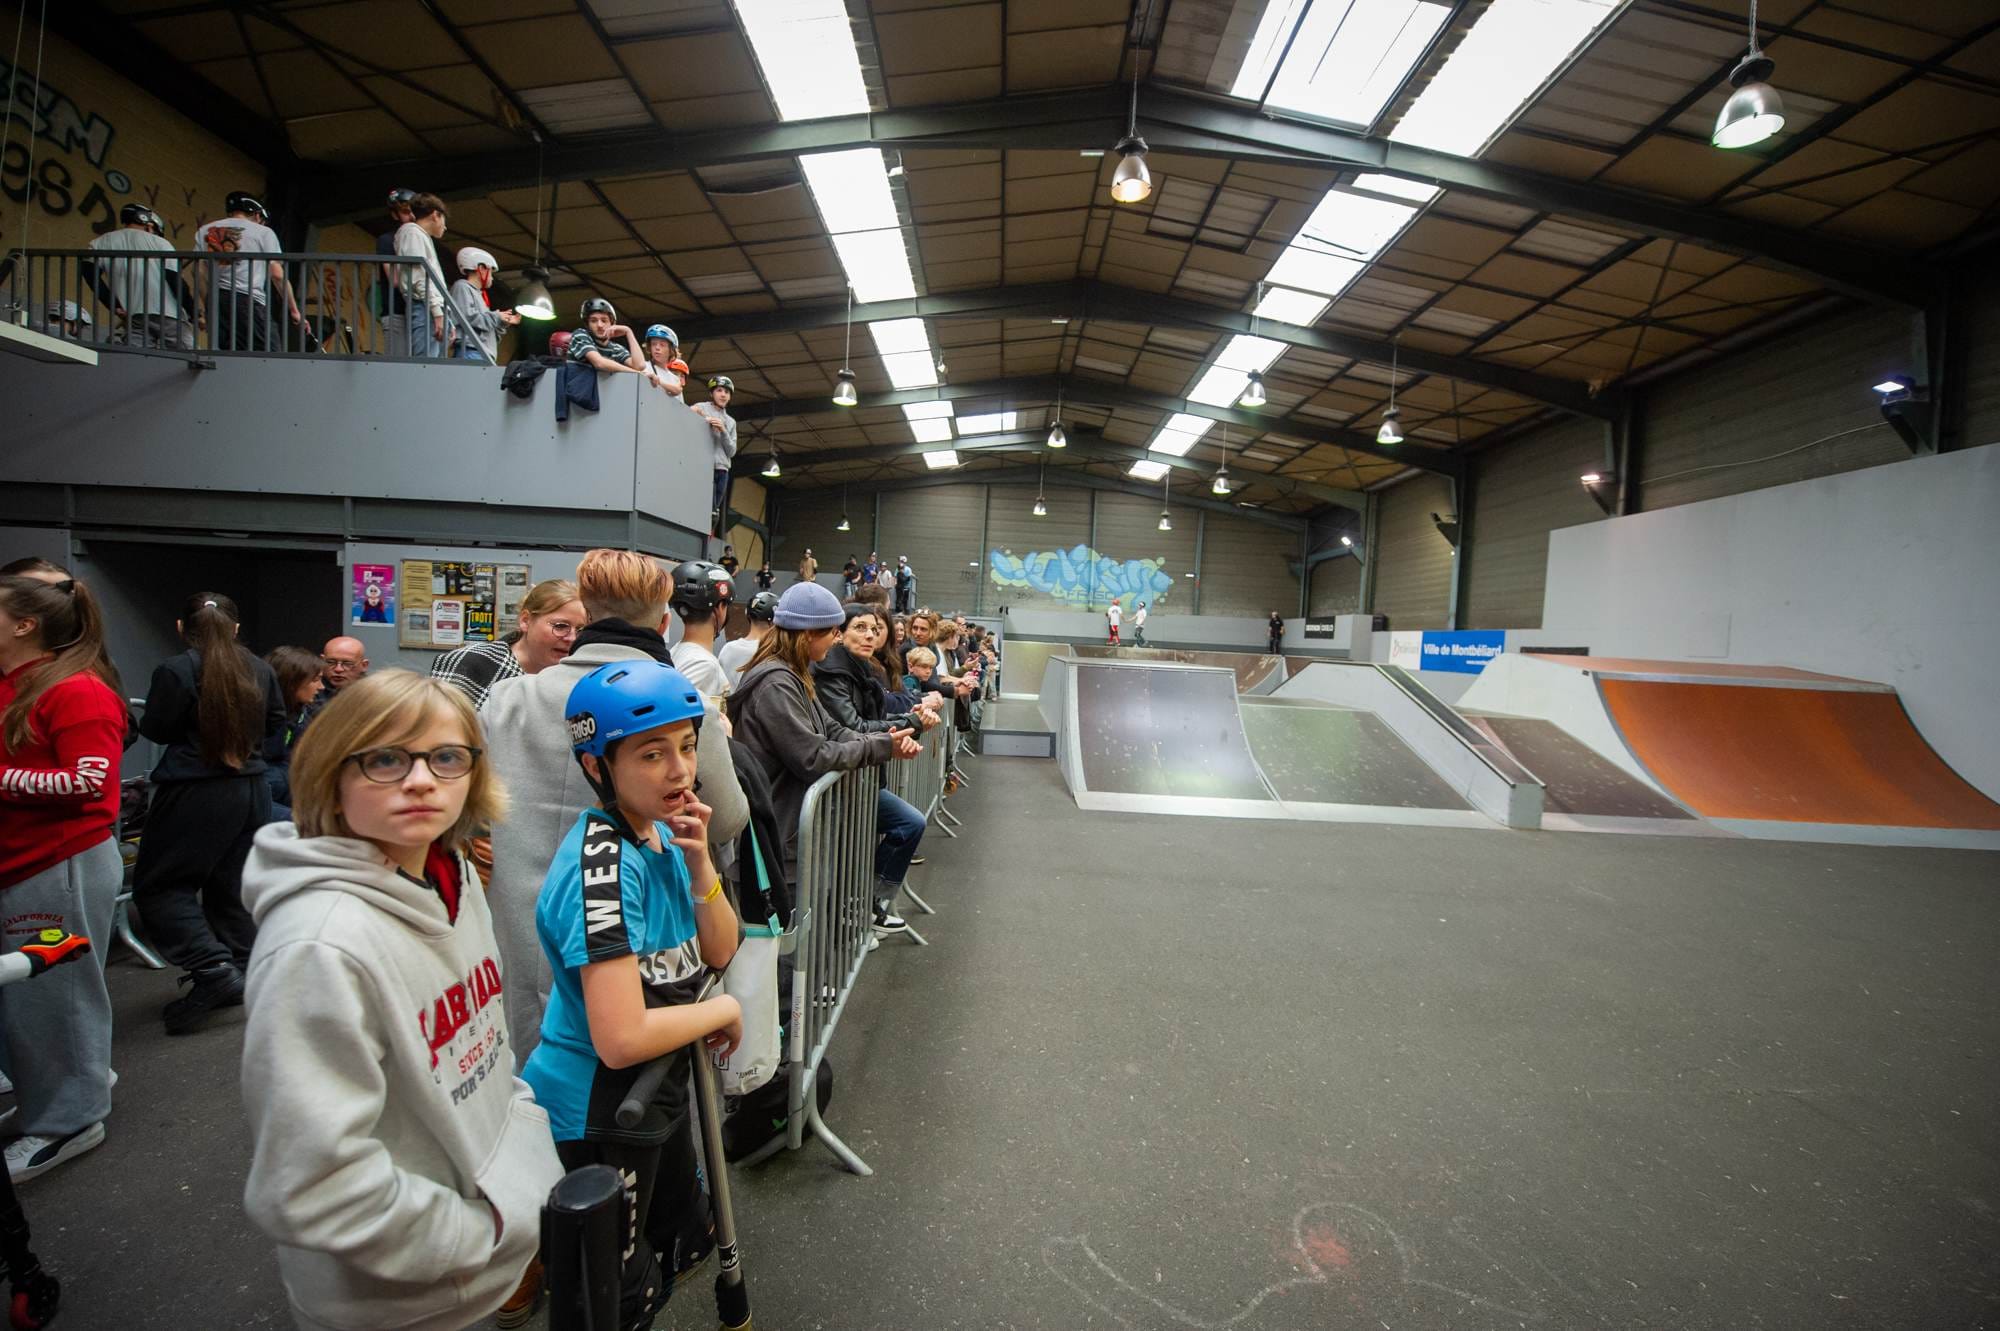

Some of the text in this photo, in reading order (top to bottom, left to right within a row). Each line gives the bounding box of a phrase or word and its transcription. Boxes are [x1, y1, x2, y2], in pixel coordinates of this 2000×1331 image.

[1423, 643, 1440, 655] Ville
[1441, 643, 1450, 655] de
[1451, 643, 1502, 656] Montbéliard
[583, 821, 622, 935] WEST
